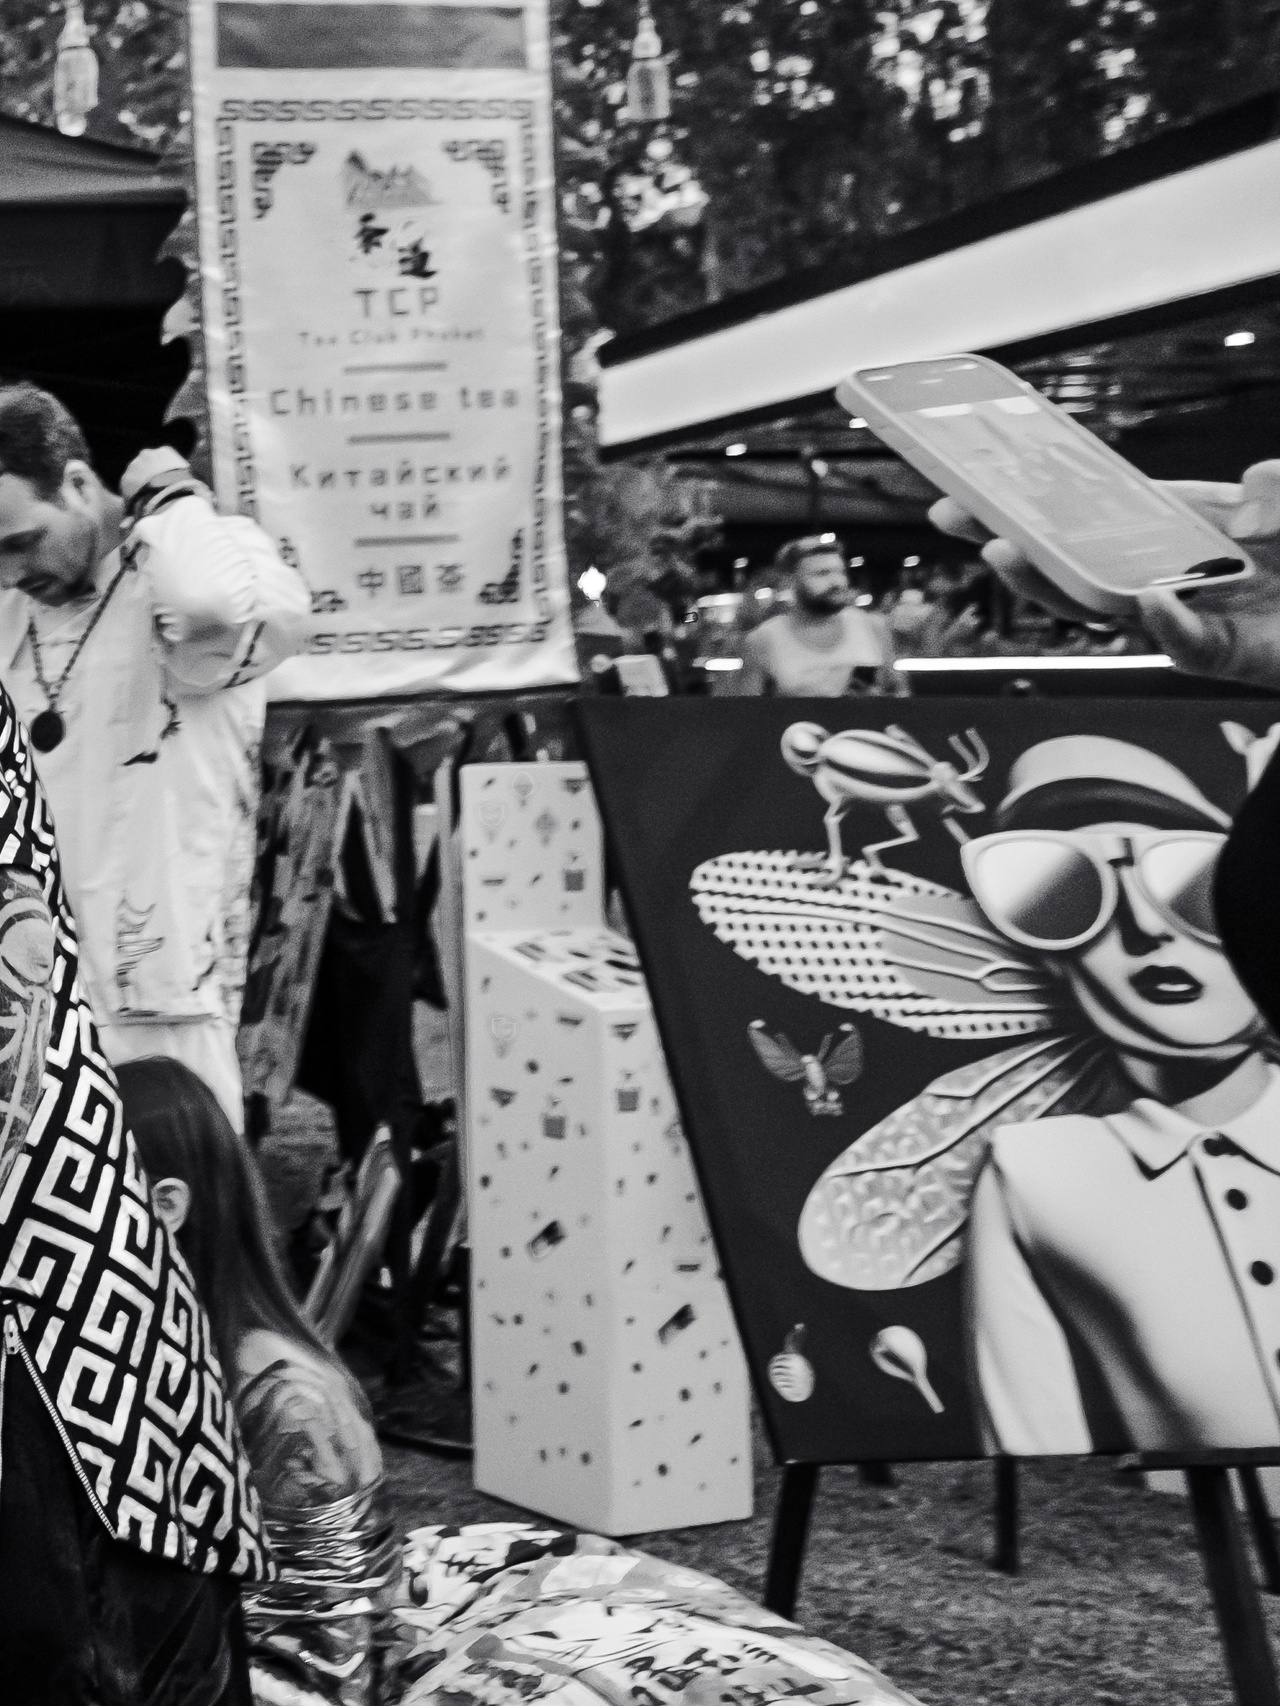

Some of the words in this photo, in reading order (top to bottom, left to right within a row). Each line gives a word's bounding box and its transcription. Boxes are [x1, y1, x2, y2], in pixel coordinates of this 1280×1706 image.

[353, 286, 440, 319] TCP
[269, 387, 438, 417] Chinese
[459, 386, 519, 410] tea
[289, 456, 511, 489] Китайский
[370, 493, 441, 520] чай
